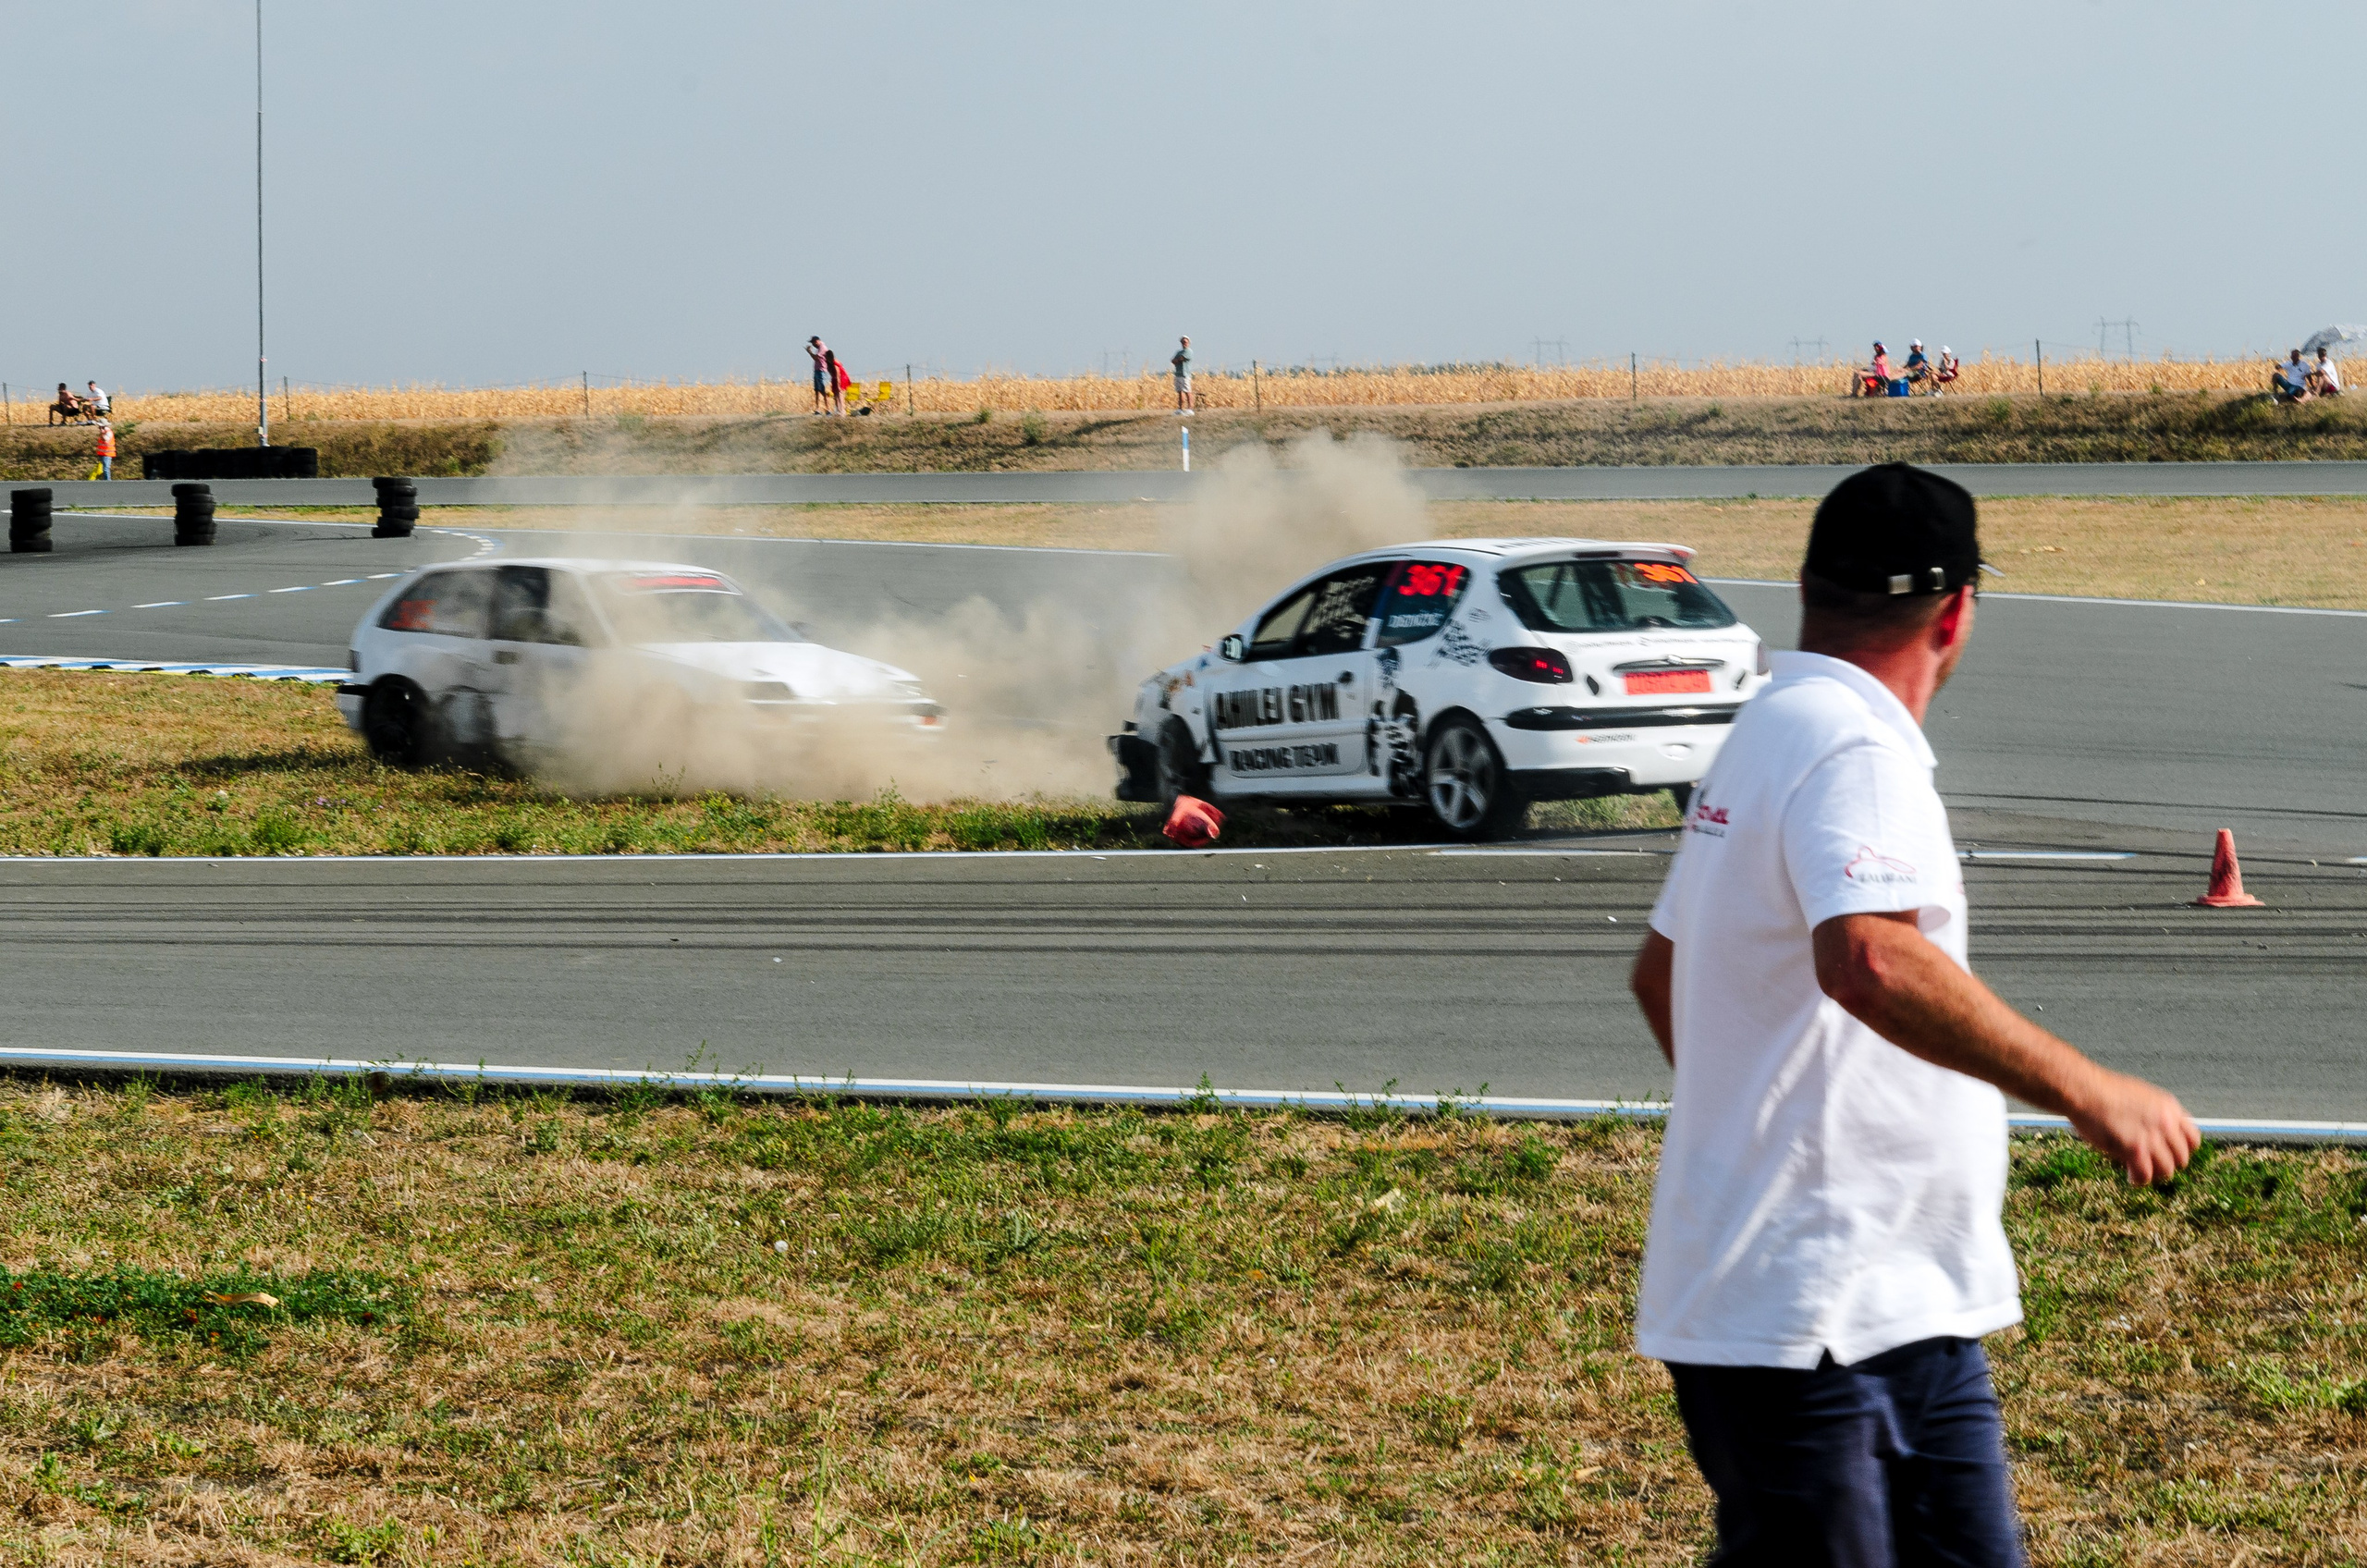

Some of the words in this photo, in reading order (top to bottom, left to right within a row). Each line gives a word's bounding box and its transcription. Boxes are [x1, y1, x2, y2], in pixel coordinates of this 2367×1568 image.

[1398, 564, 1466, 596] 361
[1633, 562, 1699, 584] 361
[1289, 682, 1340, 722] GYM
[1228, 746, 1294, 771] RACING
[1292, 743, 1340, 767] TEAM
